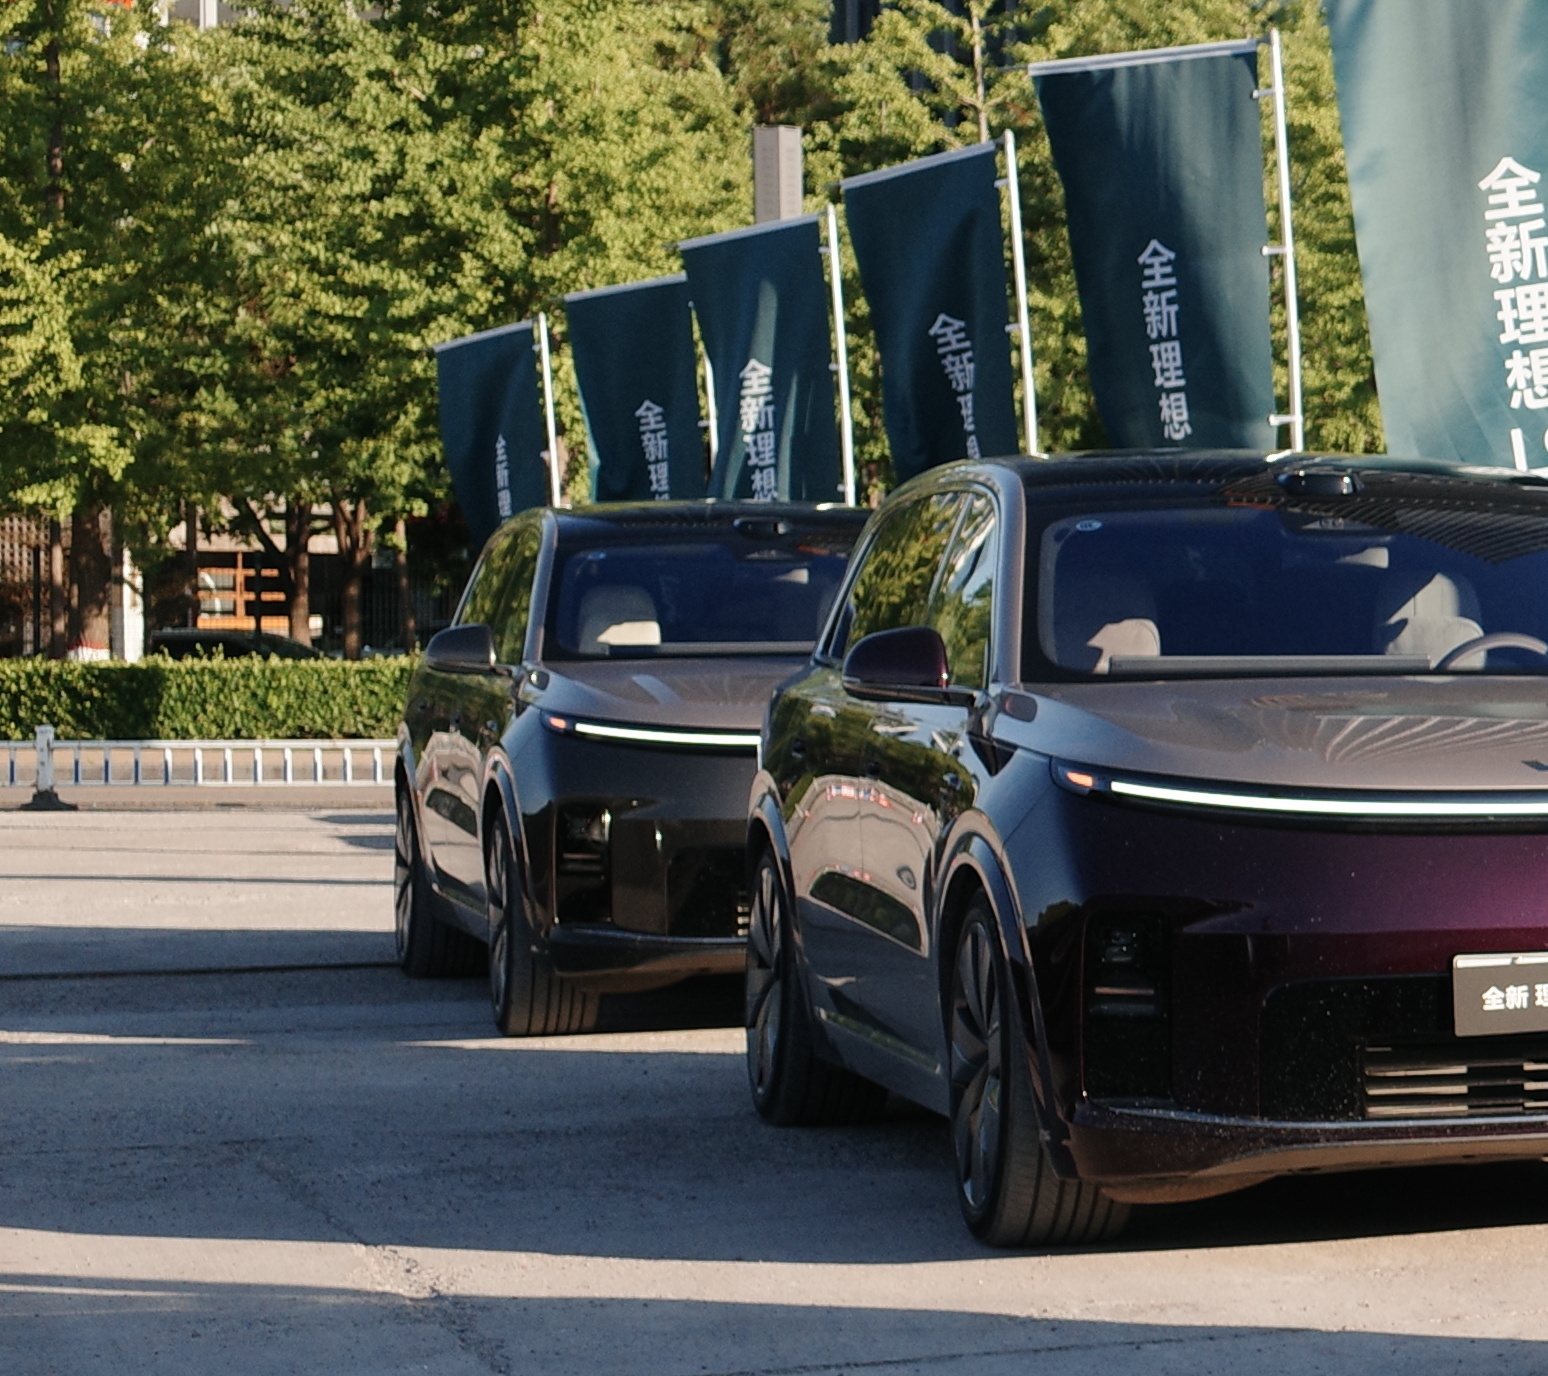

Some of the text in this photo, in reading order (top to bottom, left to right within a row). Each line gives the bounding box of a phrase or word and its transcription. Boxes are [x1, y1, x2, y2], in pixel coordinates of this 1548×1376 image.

[1137, 238, 1192, 442] 全新理想
[494, 432, 513, 525] 全新理
[634, 398, 671, 501] 全新理
[737, 358, 779, 502] 全新理想
[1481, 983, 1530, 1011] 全新
